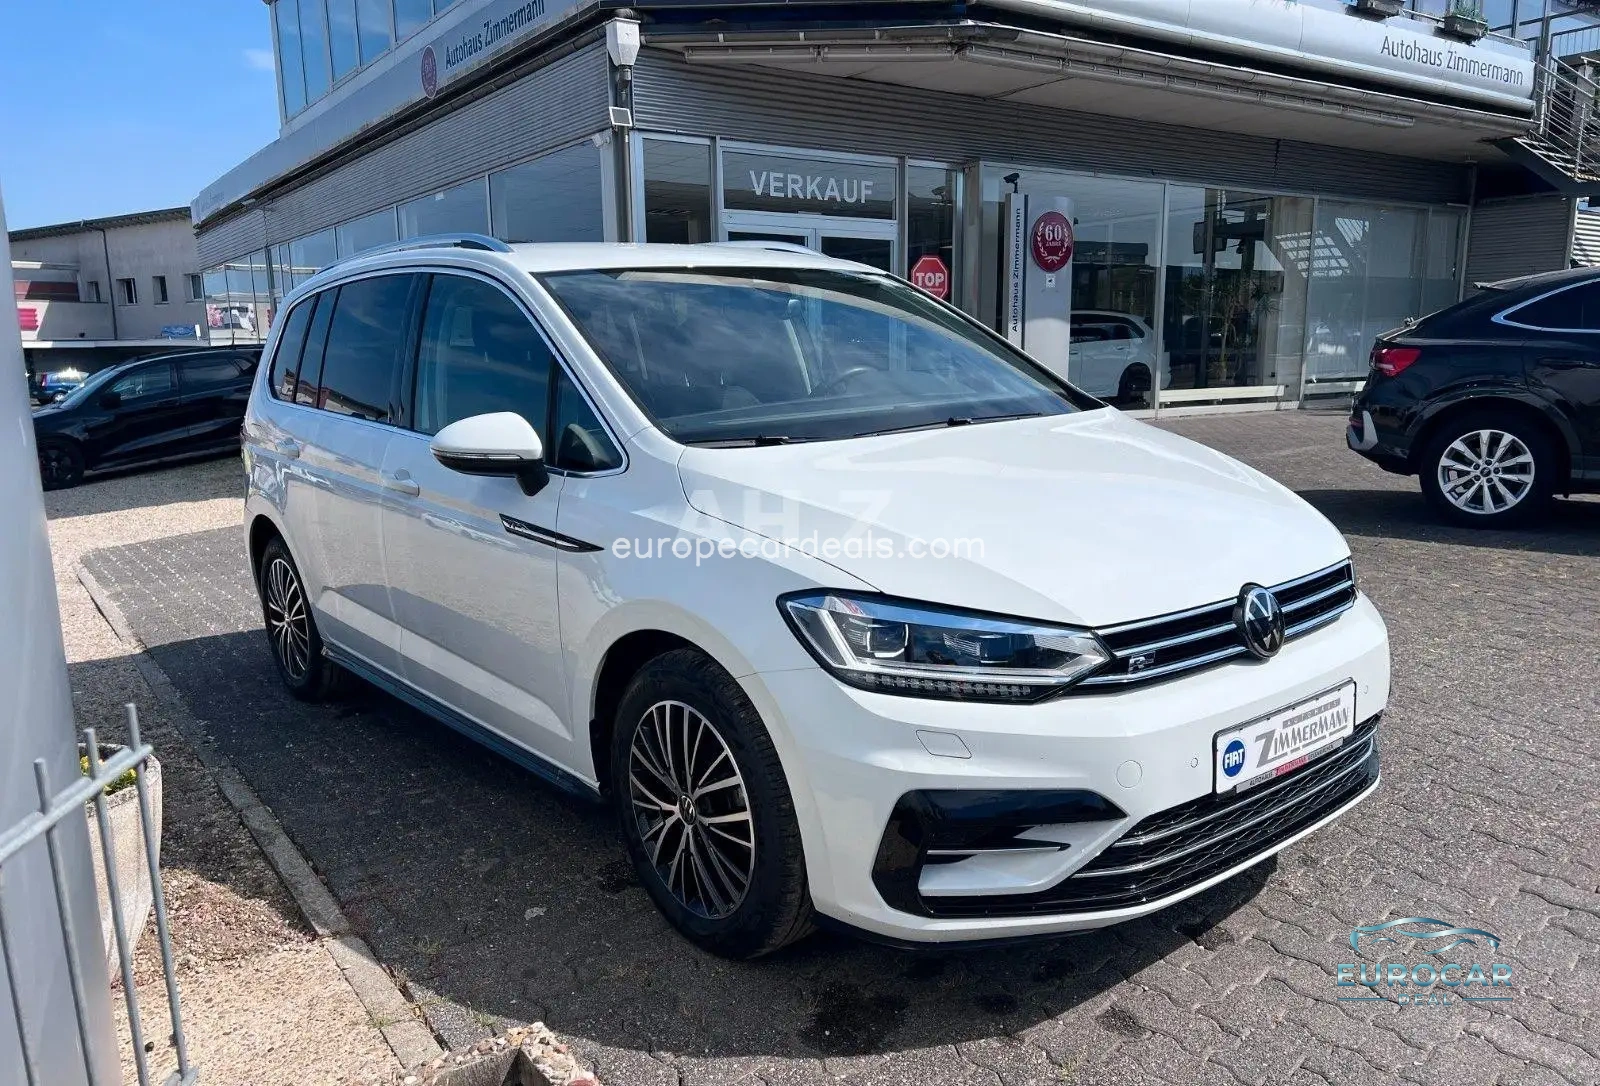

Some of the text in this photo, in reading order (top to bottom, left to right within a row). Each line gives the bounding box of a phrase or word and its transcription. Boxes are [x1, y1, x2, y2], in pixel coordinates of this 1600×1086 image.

[445, 33, 483, 70] Autohaus
[483, 0, 545, 47] Zimmermann
[1381, 36, 1523, 86] Autohaus Zimmermann
[749, 170, 874, 204] VERKAUF
[1045, 224, 1062, 241] 60
[916, 272, 945, 287] TOP
[1012, 208, 1021, 332] Autohaus Zimmermann
[1224, 748, 1245, 769] FIAT
[1255, 707, 1348, 769] ZIMMERMANN
